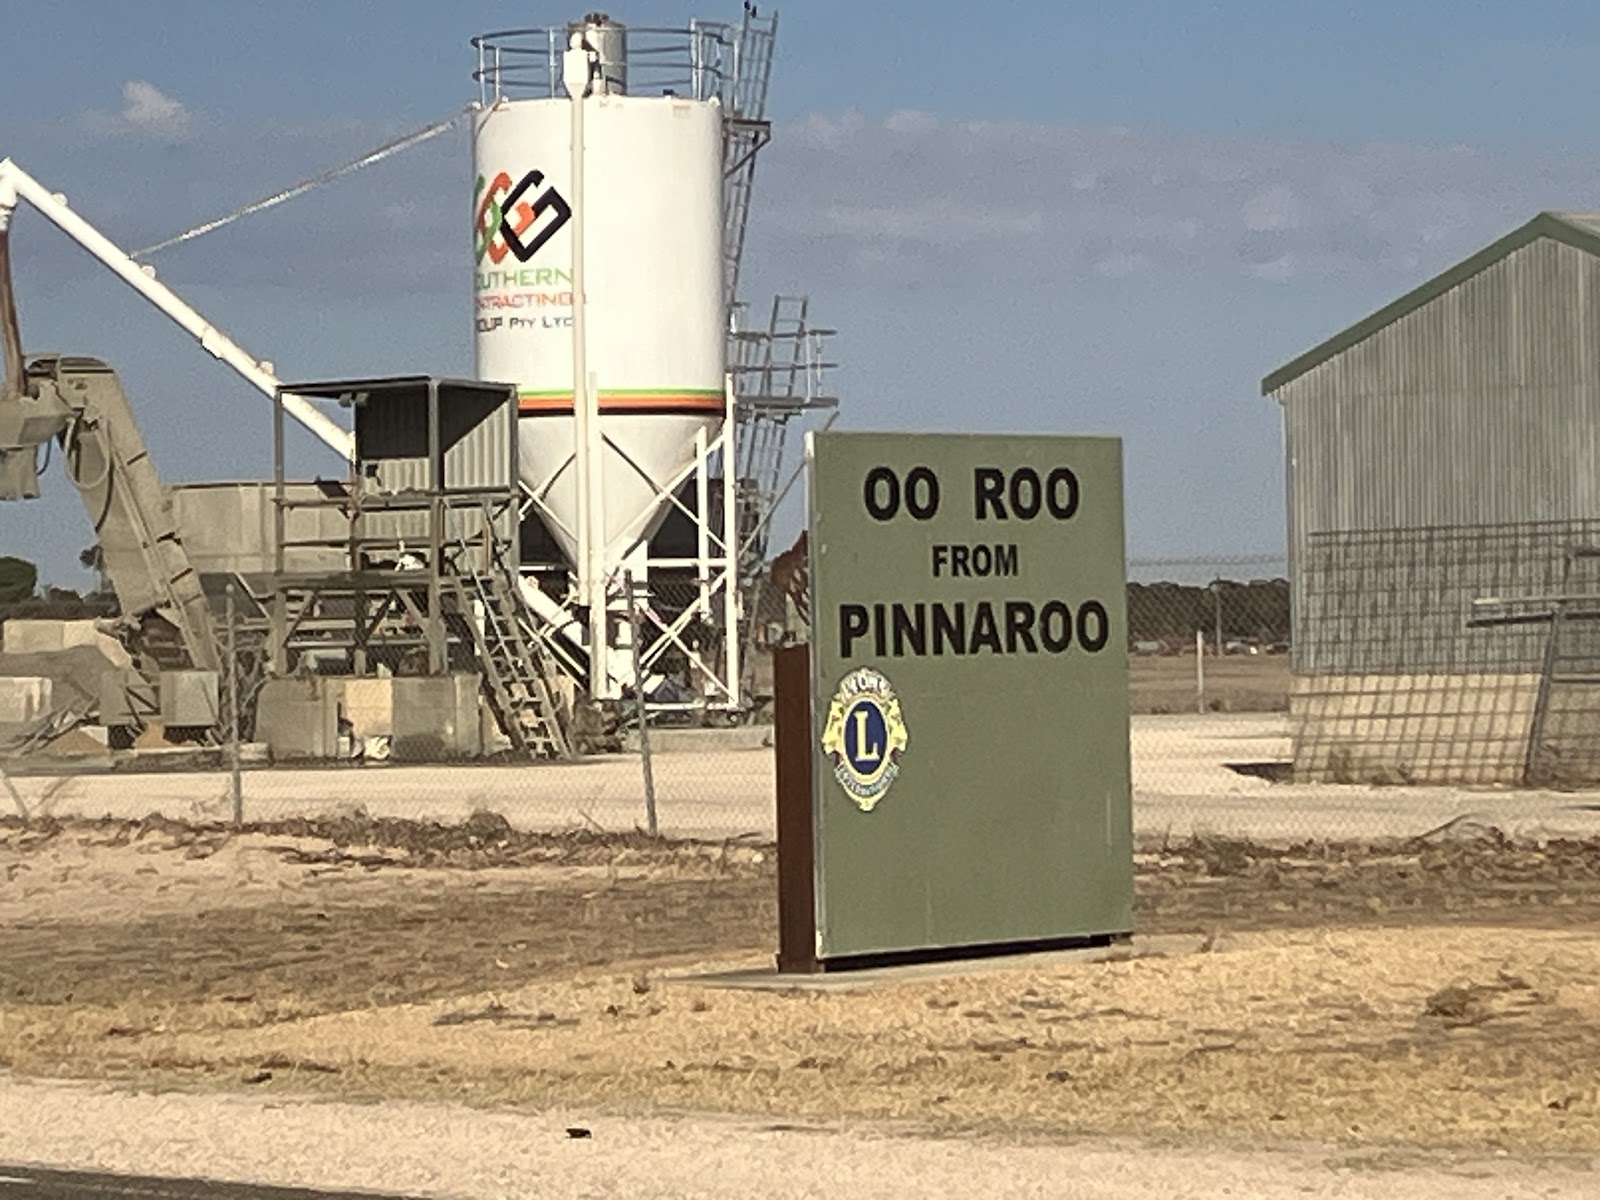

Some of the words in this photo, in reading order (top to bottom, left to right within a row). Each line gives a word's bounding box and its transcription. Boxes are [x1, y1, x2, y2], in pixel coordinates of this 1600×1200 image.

[510, 317, 536, 330] PTY
[865, 466, 939, 519] OO
[975, 467, 1079, 519] ROO
[932, 545, 1018, 576] FROM
[839, 601, 1109, 658] PINNAROO
[854, 710, 880, 762] L
